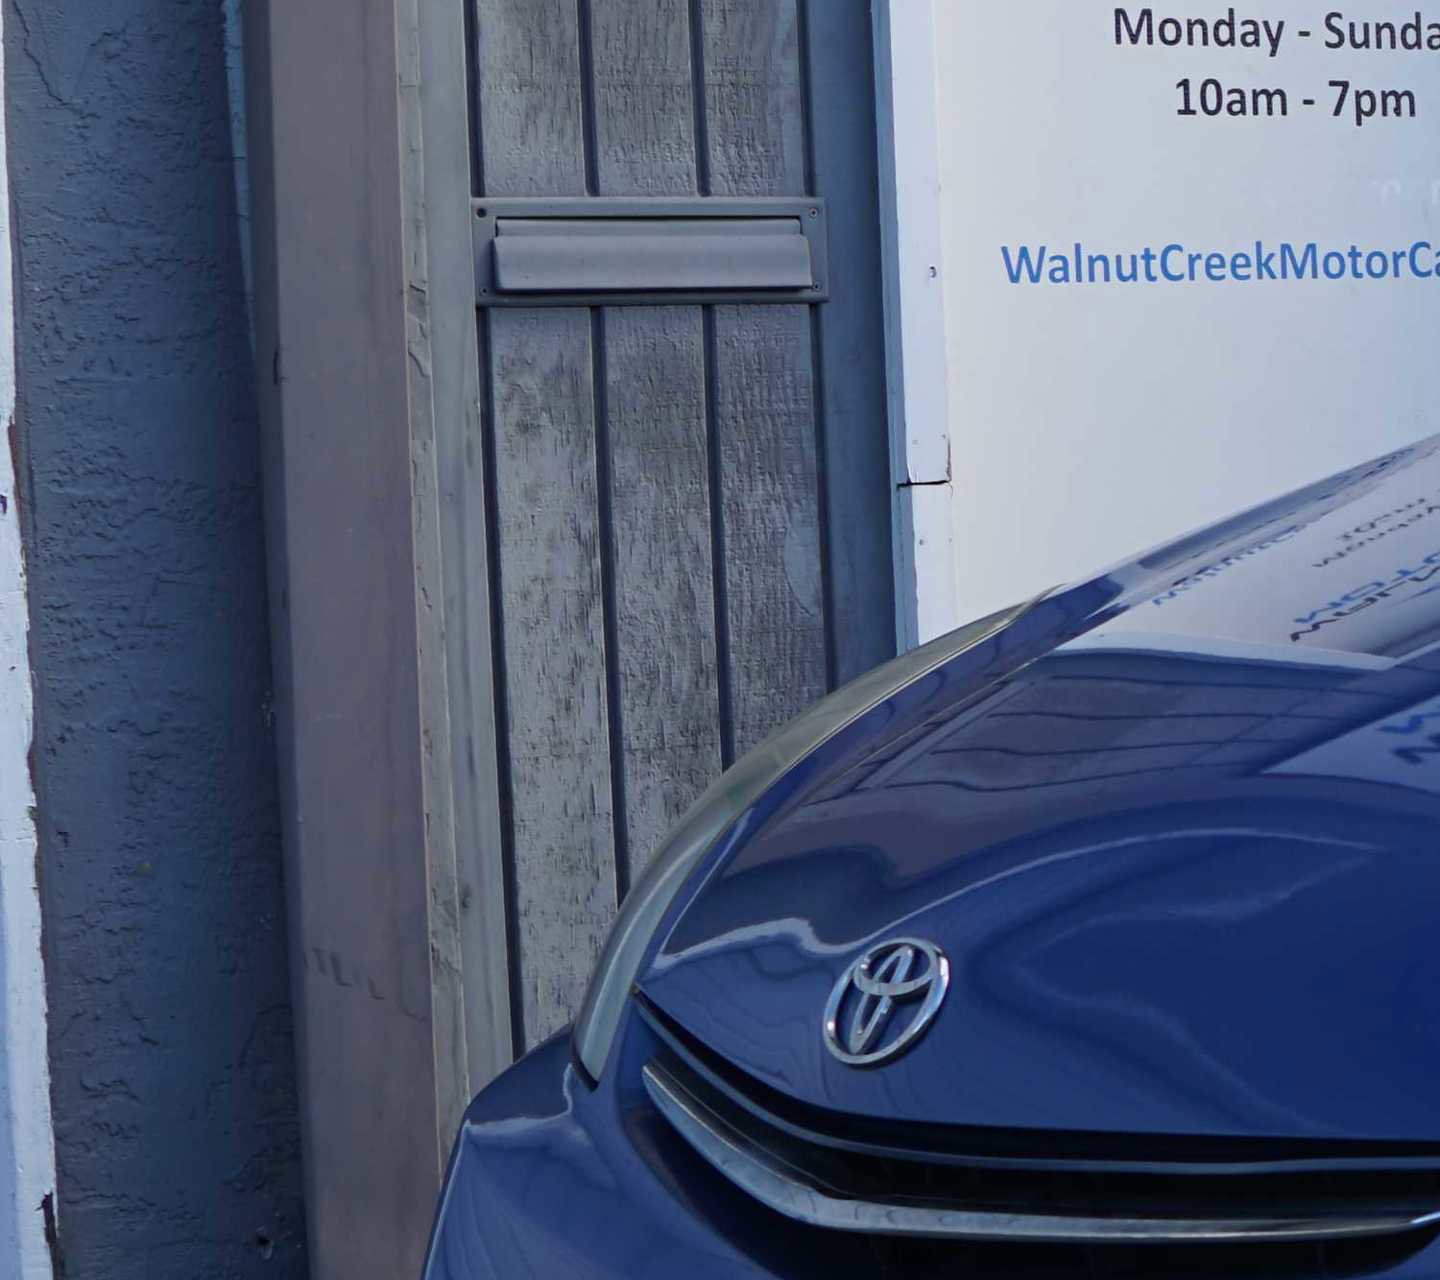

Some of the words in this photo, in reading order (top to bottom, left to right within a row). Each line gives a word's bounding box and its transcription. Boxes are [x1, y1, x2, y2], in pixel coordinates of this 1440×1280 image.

[1112, 7, 1285, 57] Monday
[1175, 78, 1288, 117] 10am
[1327, 80, 1417, 126] 7pm
